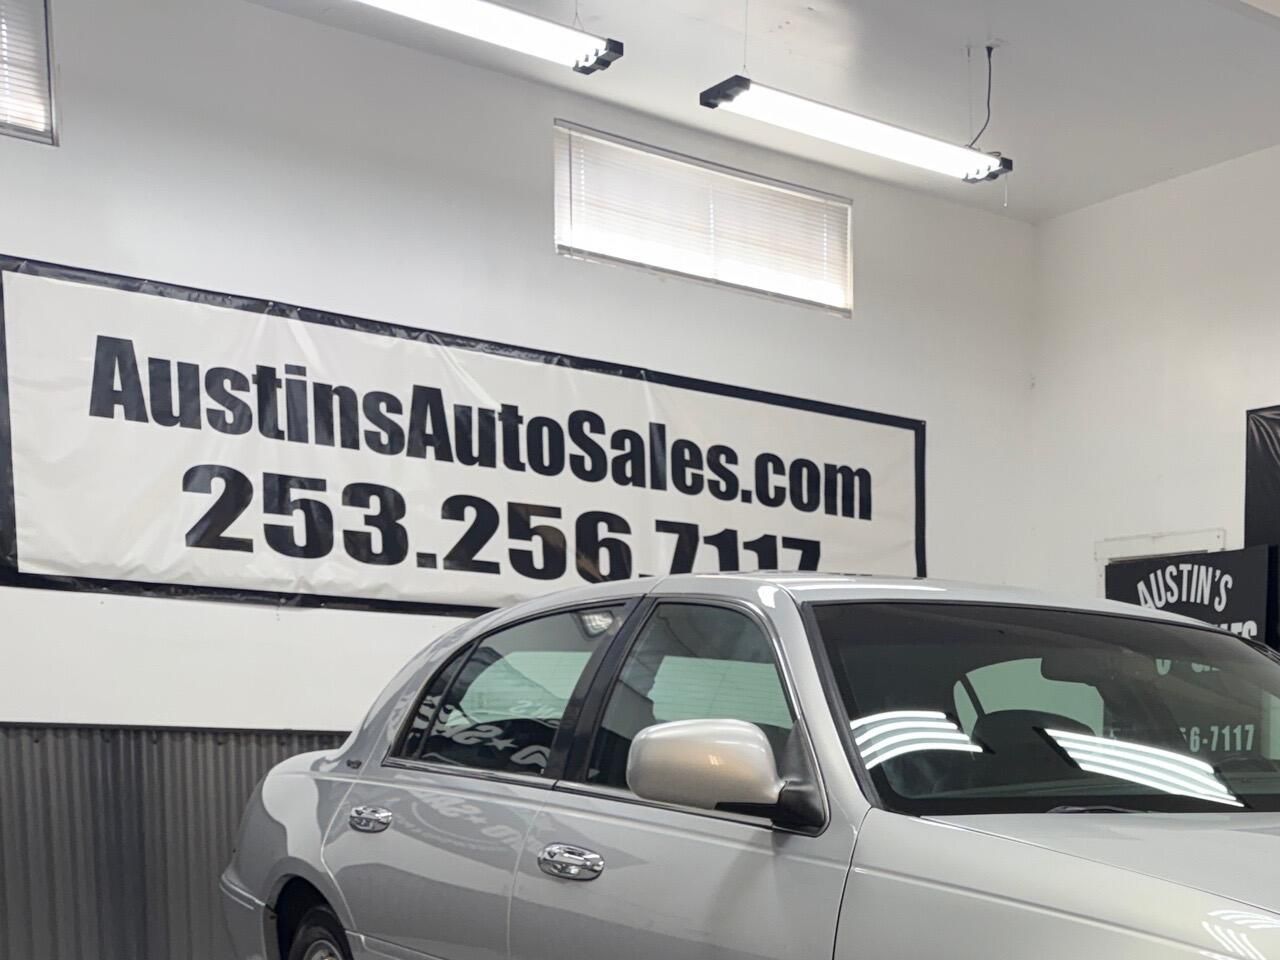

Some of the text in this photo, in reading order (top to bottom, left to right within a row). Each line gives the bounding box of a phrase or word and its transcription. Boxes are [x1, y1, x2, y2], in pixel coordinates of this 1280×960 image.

[88, 334, 872, 521] AustinsAutoSales.com
[181, 464, 821, 583] 253.2567117
[1136, 563, 1233, 612] AUSTIN'S
